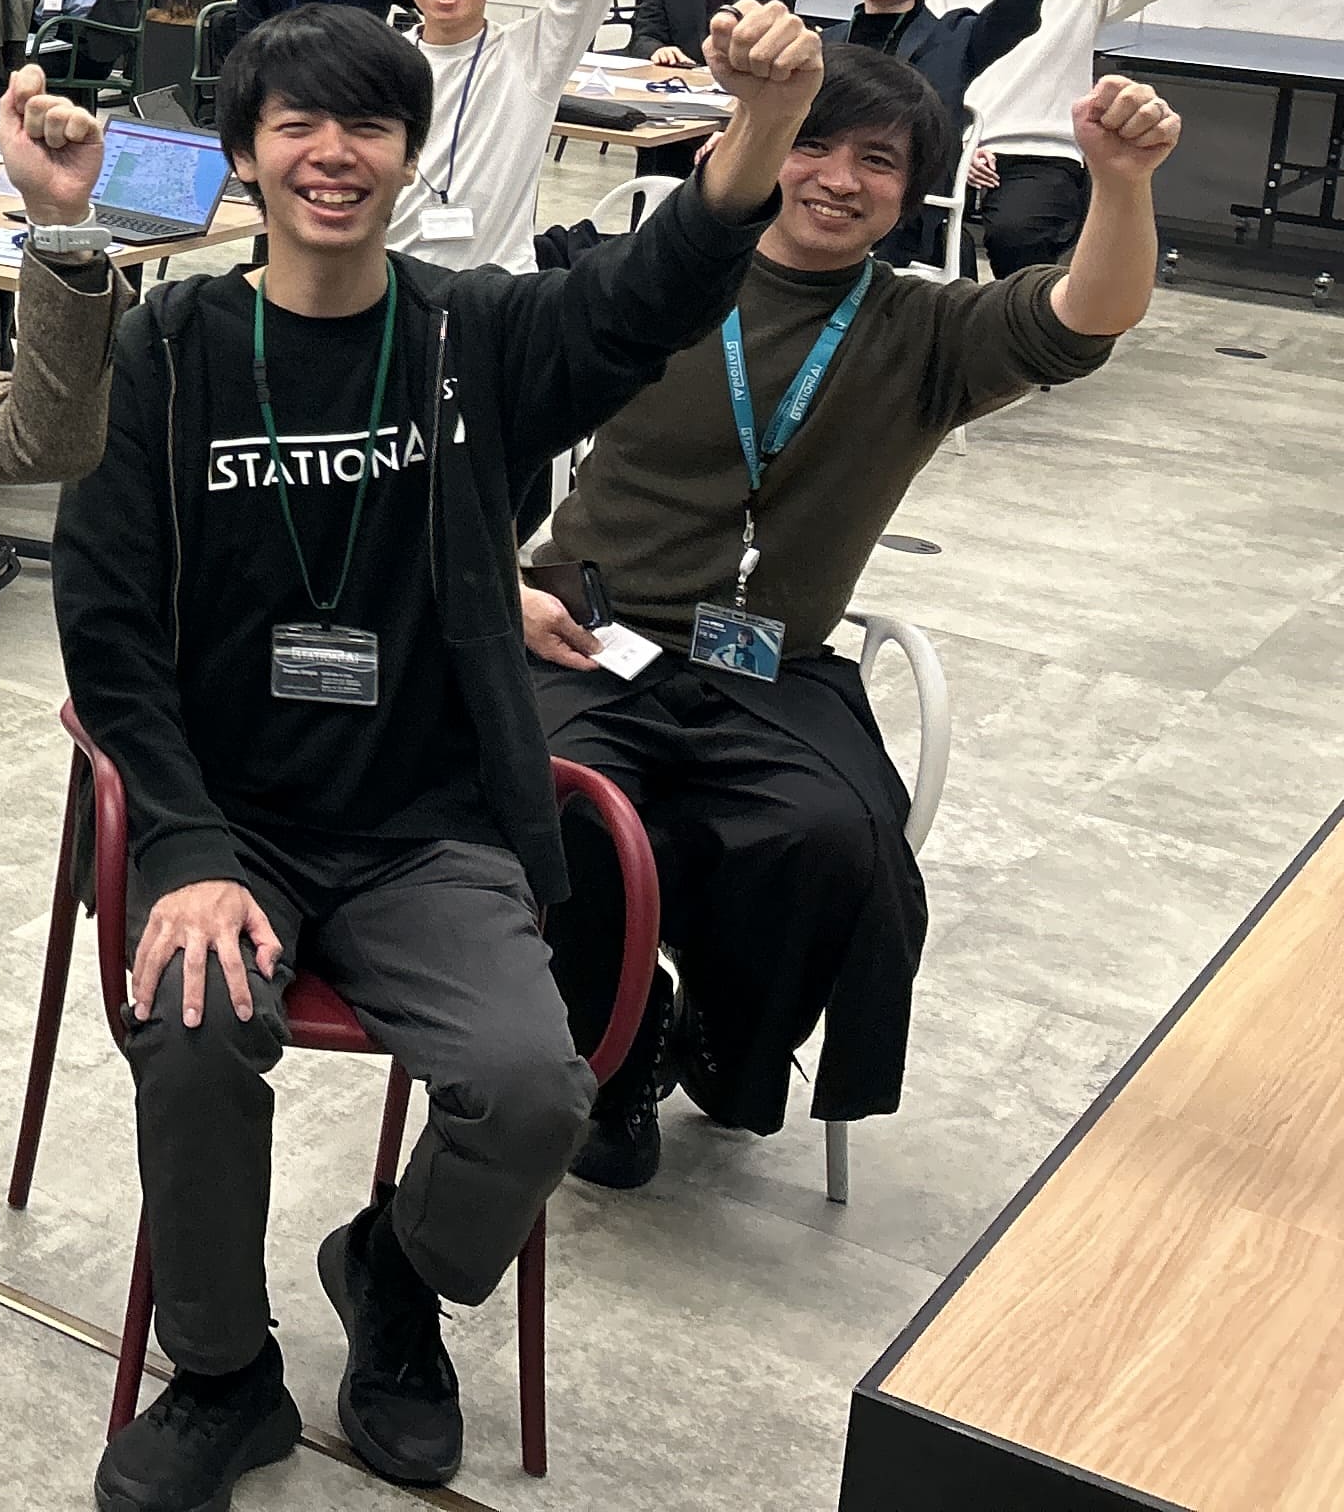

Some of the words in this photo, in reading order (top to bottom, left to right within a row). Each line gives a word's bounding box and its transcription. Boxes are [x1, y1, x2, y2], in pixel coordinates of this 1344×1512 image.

[727, 341, 745, 388] STATION
[790, 374, 817, 422] STATION
[208, 439, 401, 491] STATION
